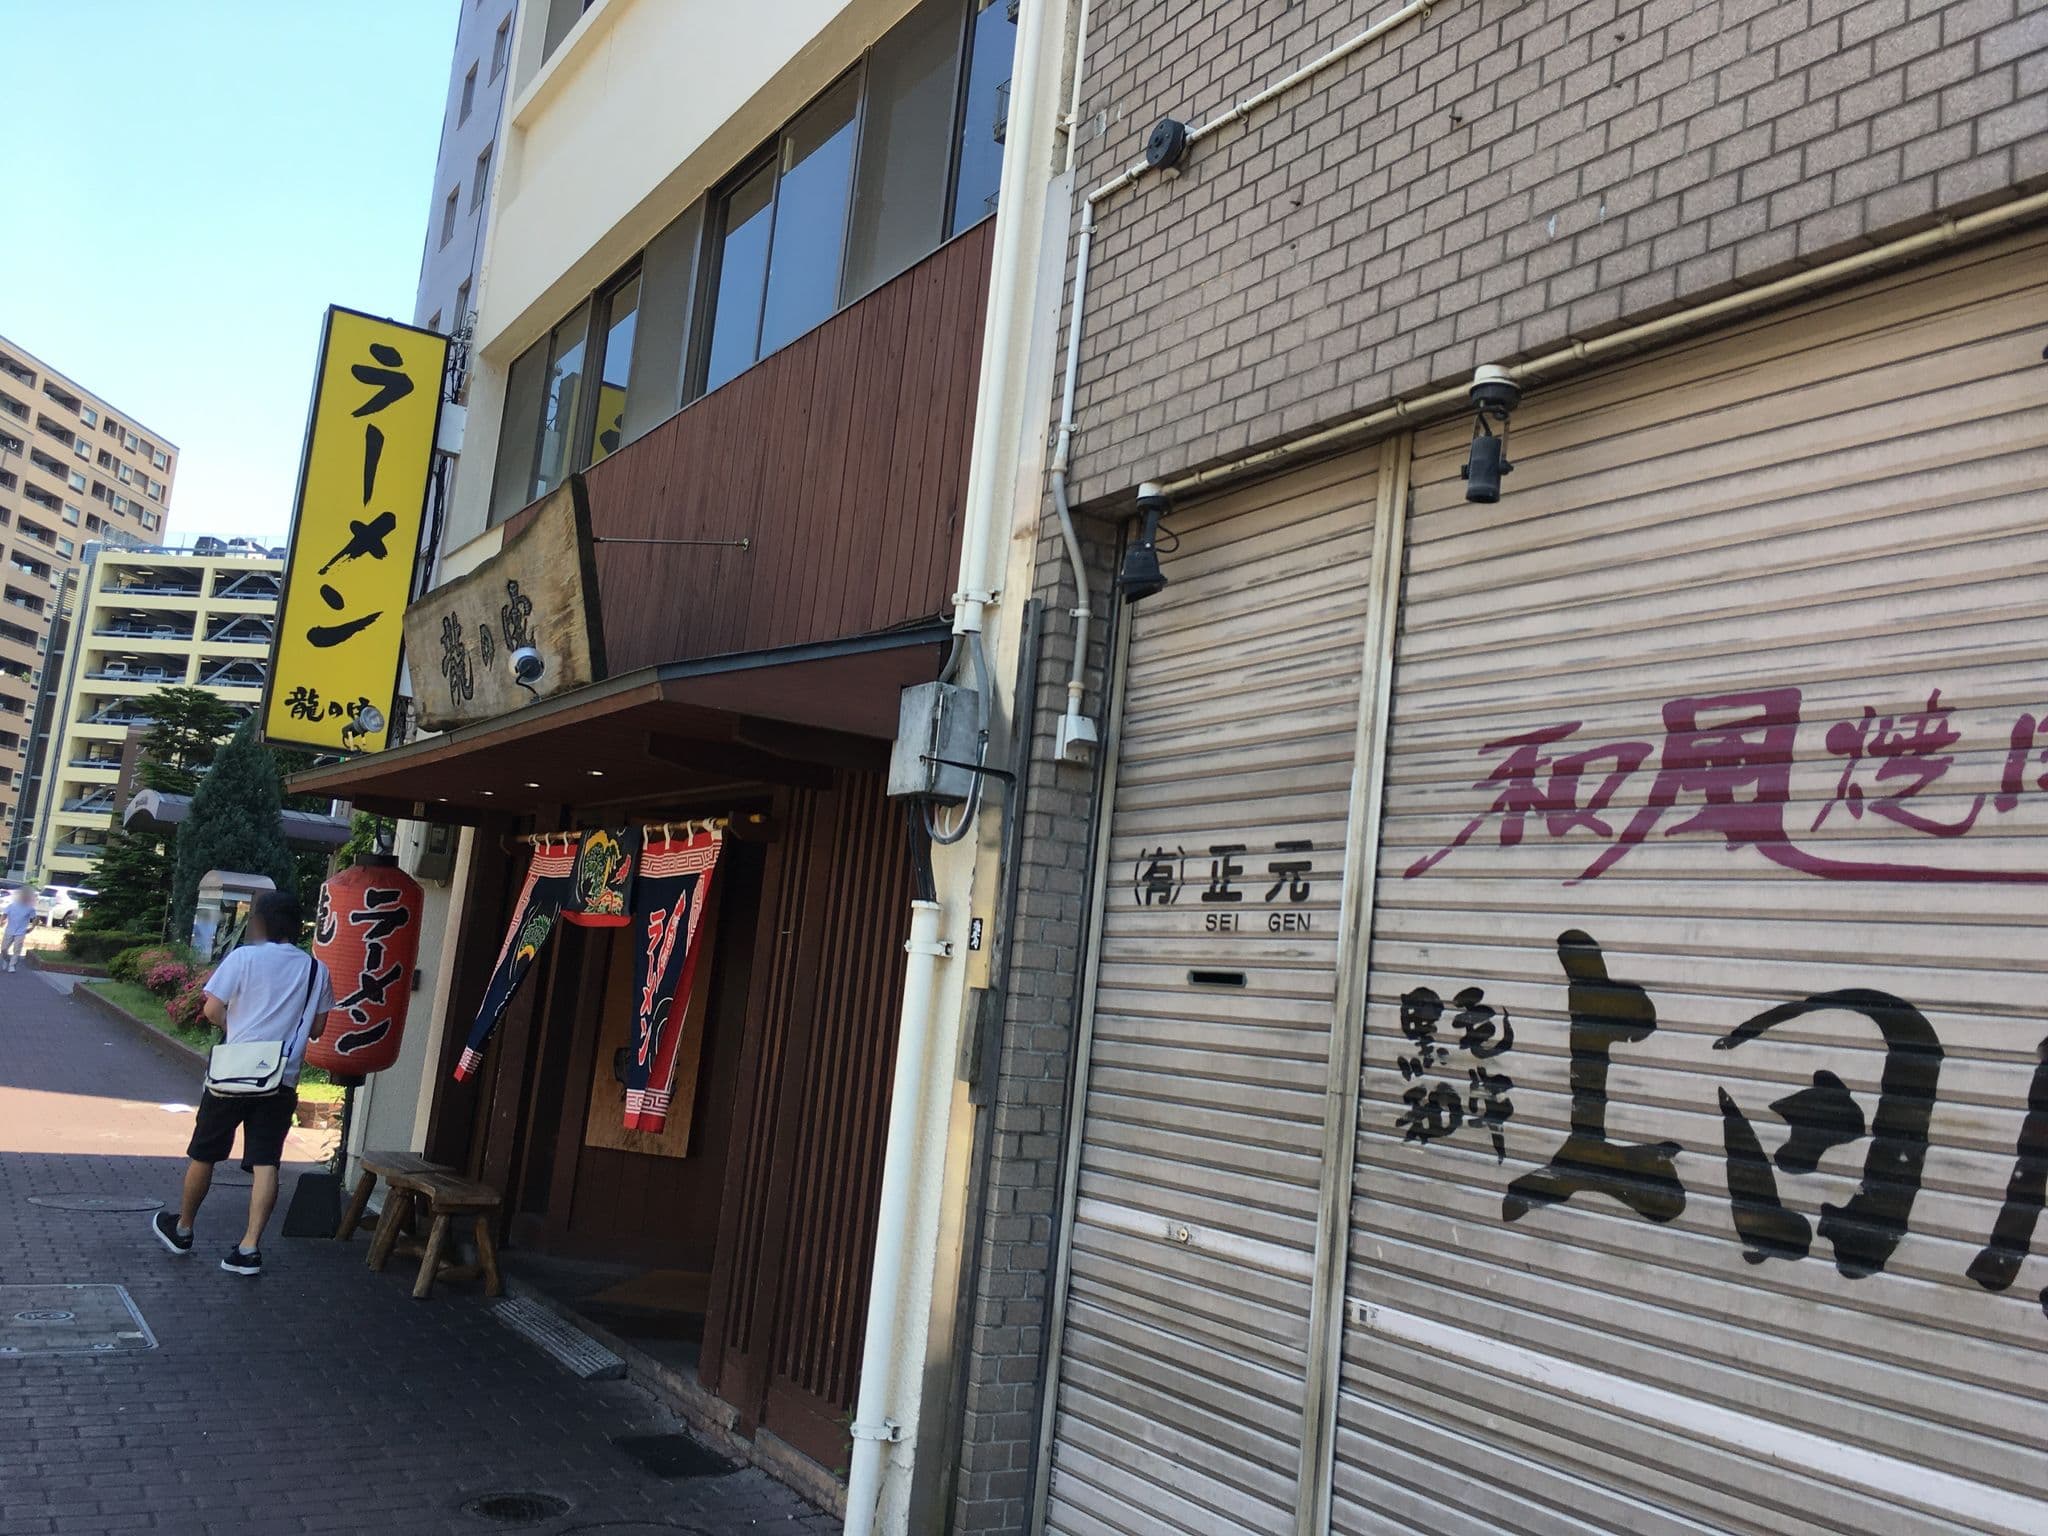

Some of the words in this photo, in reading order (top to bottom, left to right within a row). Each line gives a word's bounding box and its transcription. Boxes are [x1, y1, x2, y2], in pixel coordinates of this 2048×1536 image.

[306, 342, 415, 648] ラーメン
[1402, 687, 2048, 887] 和風焼
[335, 887, 411, 1056] ラーメン
[638, 907, 666, 1067] ラーメン
[1205, 913, 1239, 932] SEI
[1268, 912, 1312, 932] GEN
[1501, 928, 2048, 1320] 上の
